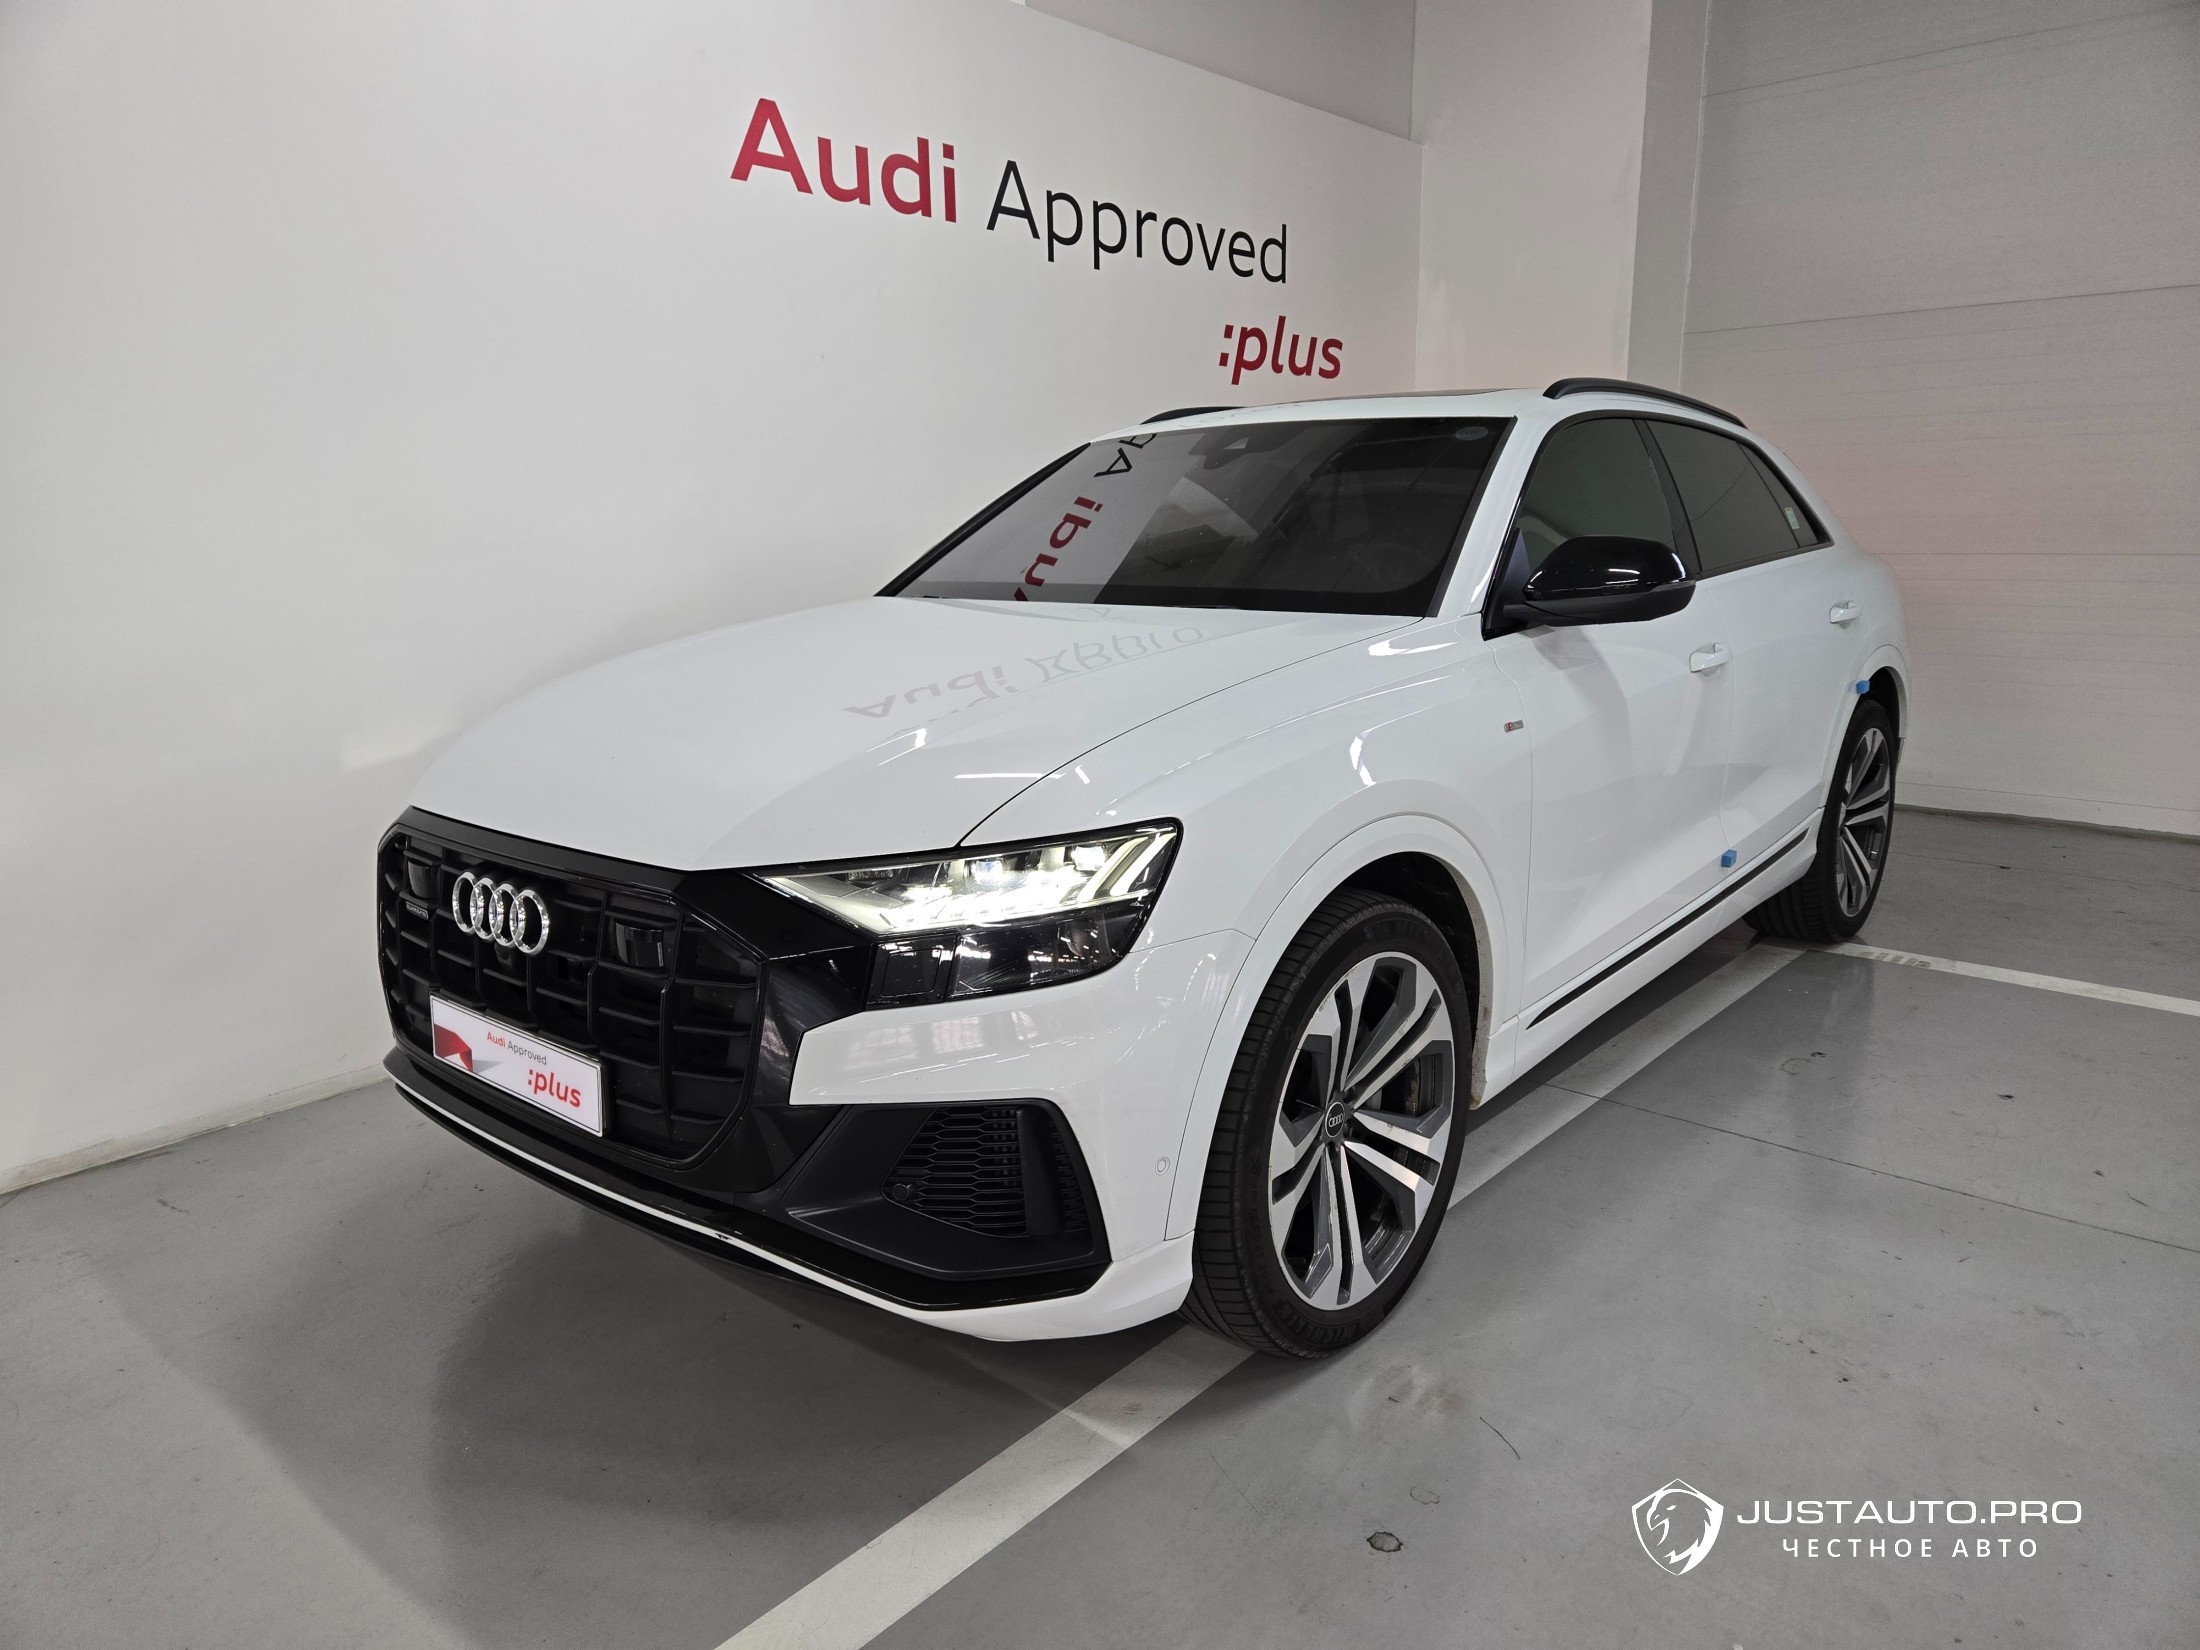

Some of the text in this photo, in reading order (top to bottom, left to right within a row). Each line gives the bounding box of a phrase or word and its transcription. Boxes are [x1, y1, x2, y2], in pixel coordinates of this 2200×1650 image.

[730, 97, 1288, 284] Audi Approved
[1218, 315, 1343, 386] :plus
[487, 1031, 547, 1066] Audi Approved
[527, 1068, 582, 1108] :plus
